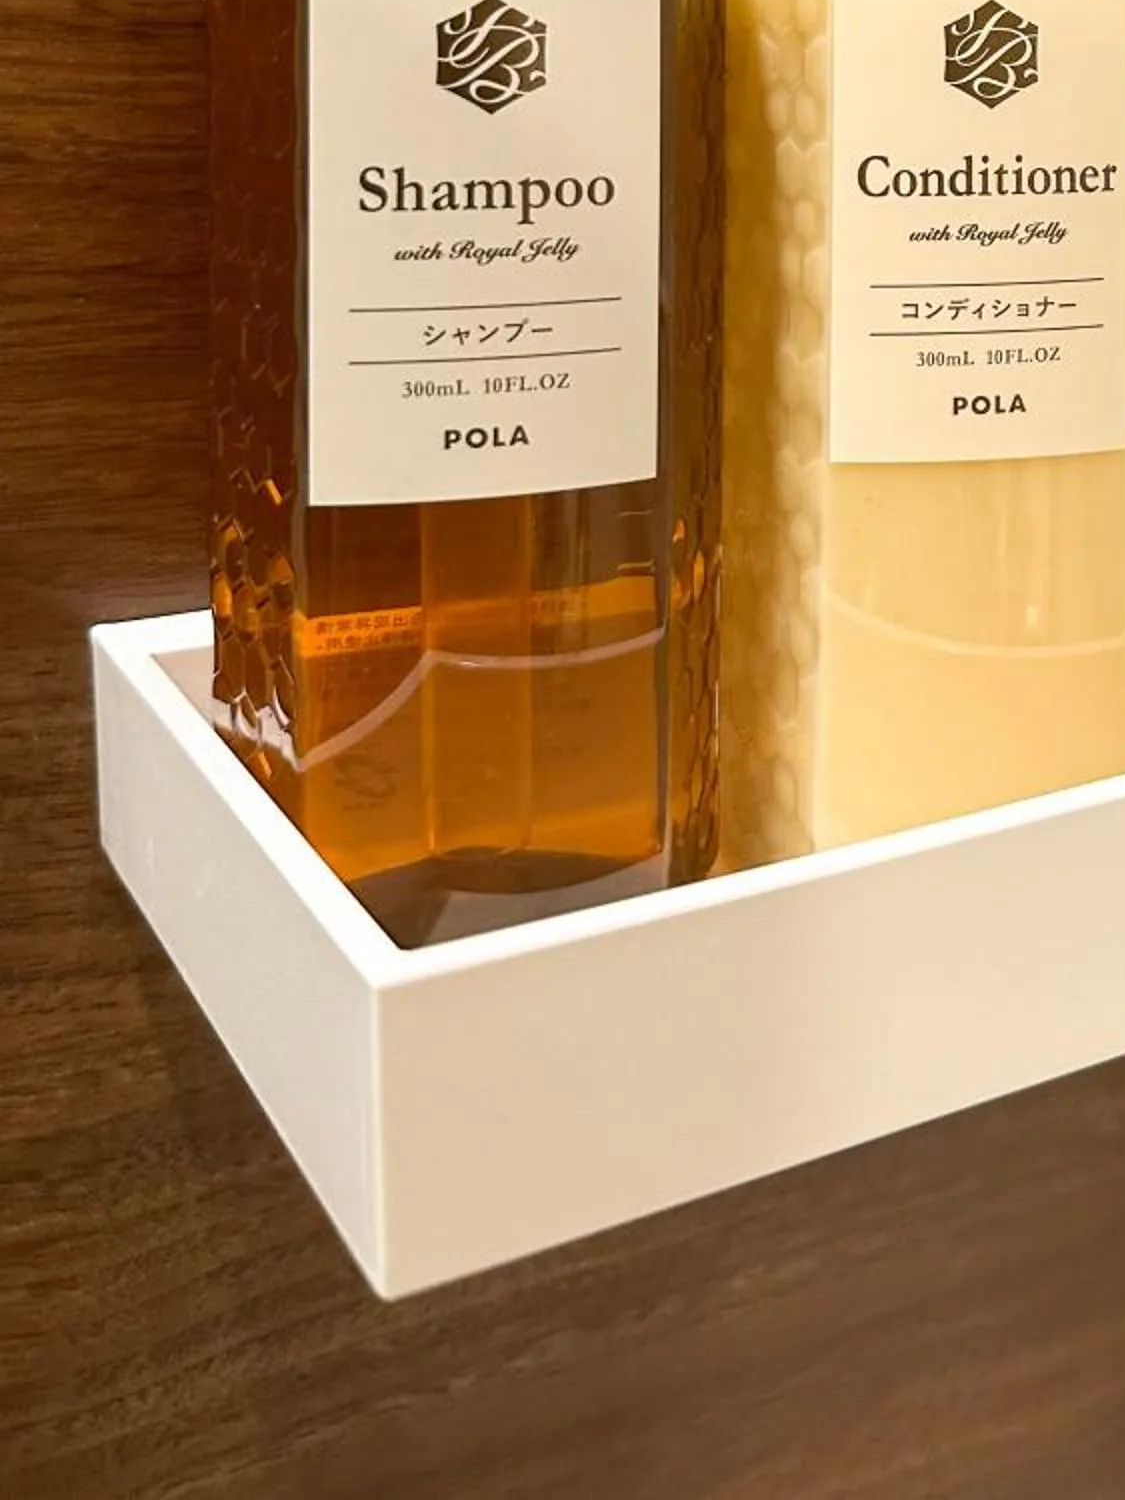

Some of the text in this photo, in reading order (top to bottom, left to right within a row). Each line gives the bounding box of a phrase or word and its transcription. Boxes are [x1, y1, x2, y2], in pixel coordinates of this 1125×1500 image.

[857, 154, 1118, 198] Conditioner
[359, 166, 615, 226] Shampoo
[909, 221, 1068, 247] with Royal Jelly
[393, 236, 579, 266] with Royal Jelly
[901, 295, 1077, 321] コンディショナー
[423, 318, 553, 346] シャンプー
[916, 346, 1061, 368] 300mL 10FL.OZ
[402, 372, 571, 398] 300mL 10FL.OZ
[952, 393, 1027, 416] POLA
[443, 425, 529, 451] POLA
